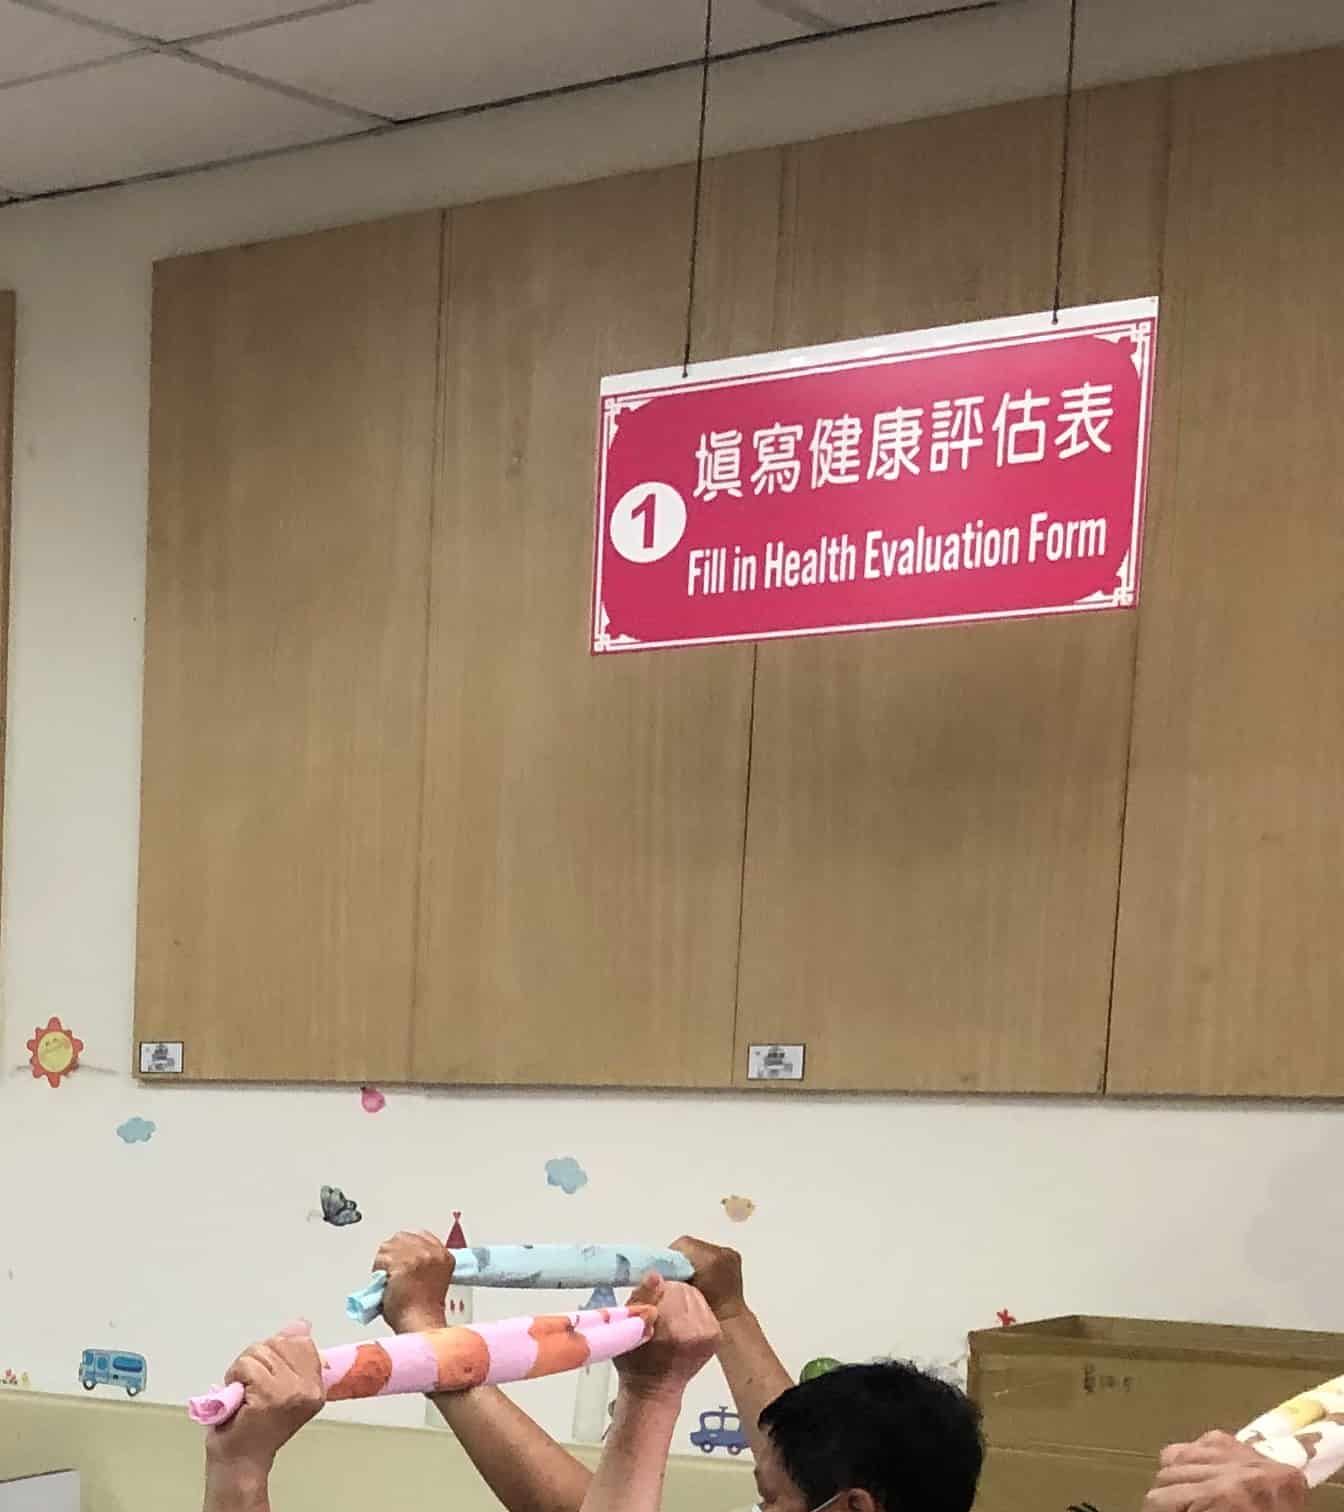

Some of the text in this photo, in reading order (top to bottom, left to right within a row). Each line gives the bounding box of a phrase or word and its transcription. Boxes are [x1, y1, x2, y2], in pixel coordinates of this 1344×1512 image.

[688, 511, 1107, 596] Fill in Health Evaluation Form
